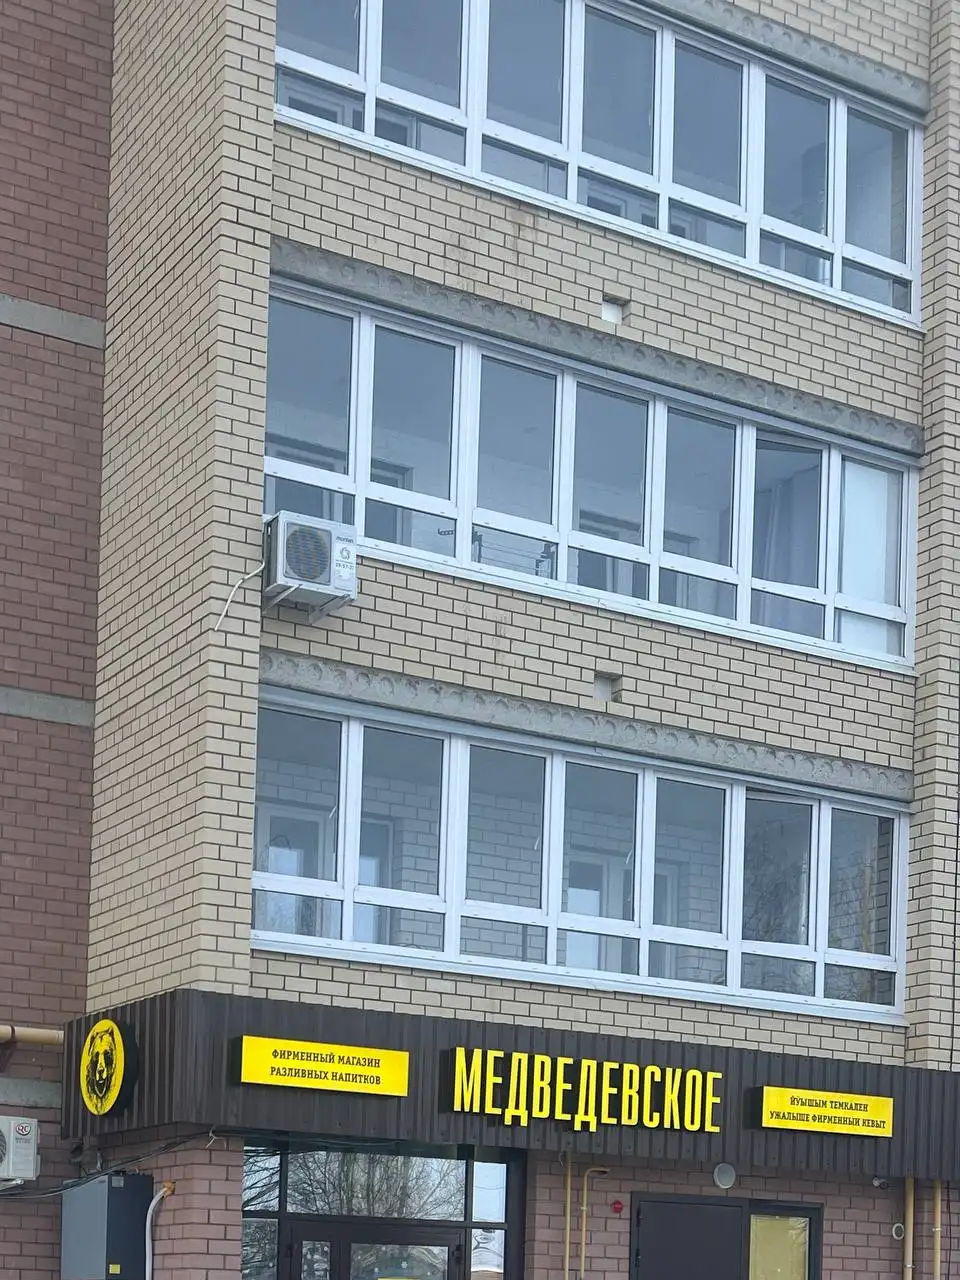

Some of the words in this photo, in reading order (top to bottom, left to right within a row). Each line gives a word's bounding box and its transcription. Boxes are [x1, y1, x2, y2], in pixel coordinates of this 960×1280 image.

[271, 1049, 335, 1064] ФИРМЕННЫЙ
[337, 1055, 381, 1068] МАГАЗИН
[270, 1066, 329, 1080] РАЗЛИВНЫХ
[331, 1072, 381, 1085] НАПИТКОВ
[453, 1046, 723, 1133] МЕДВЕДЕВСКОЕ
